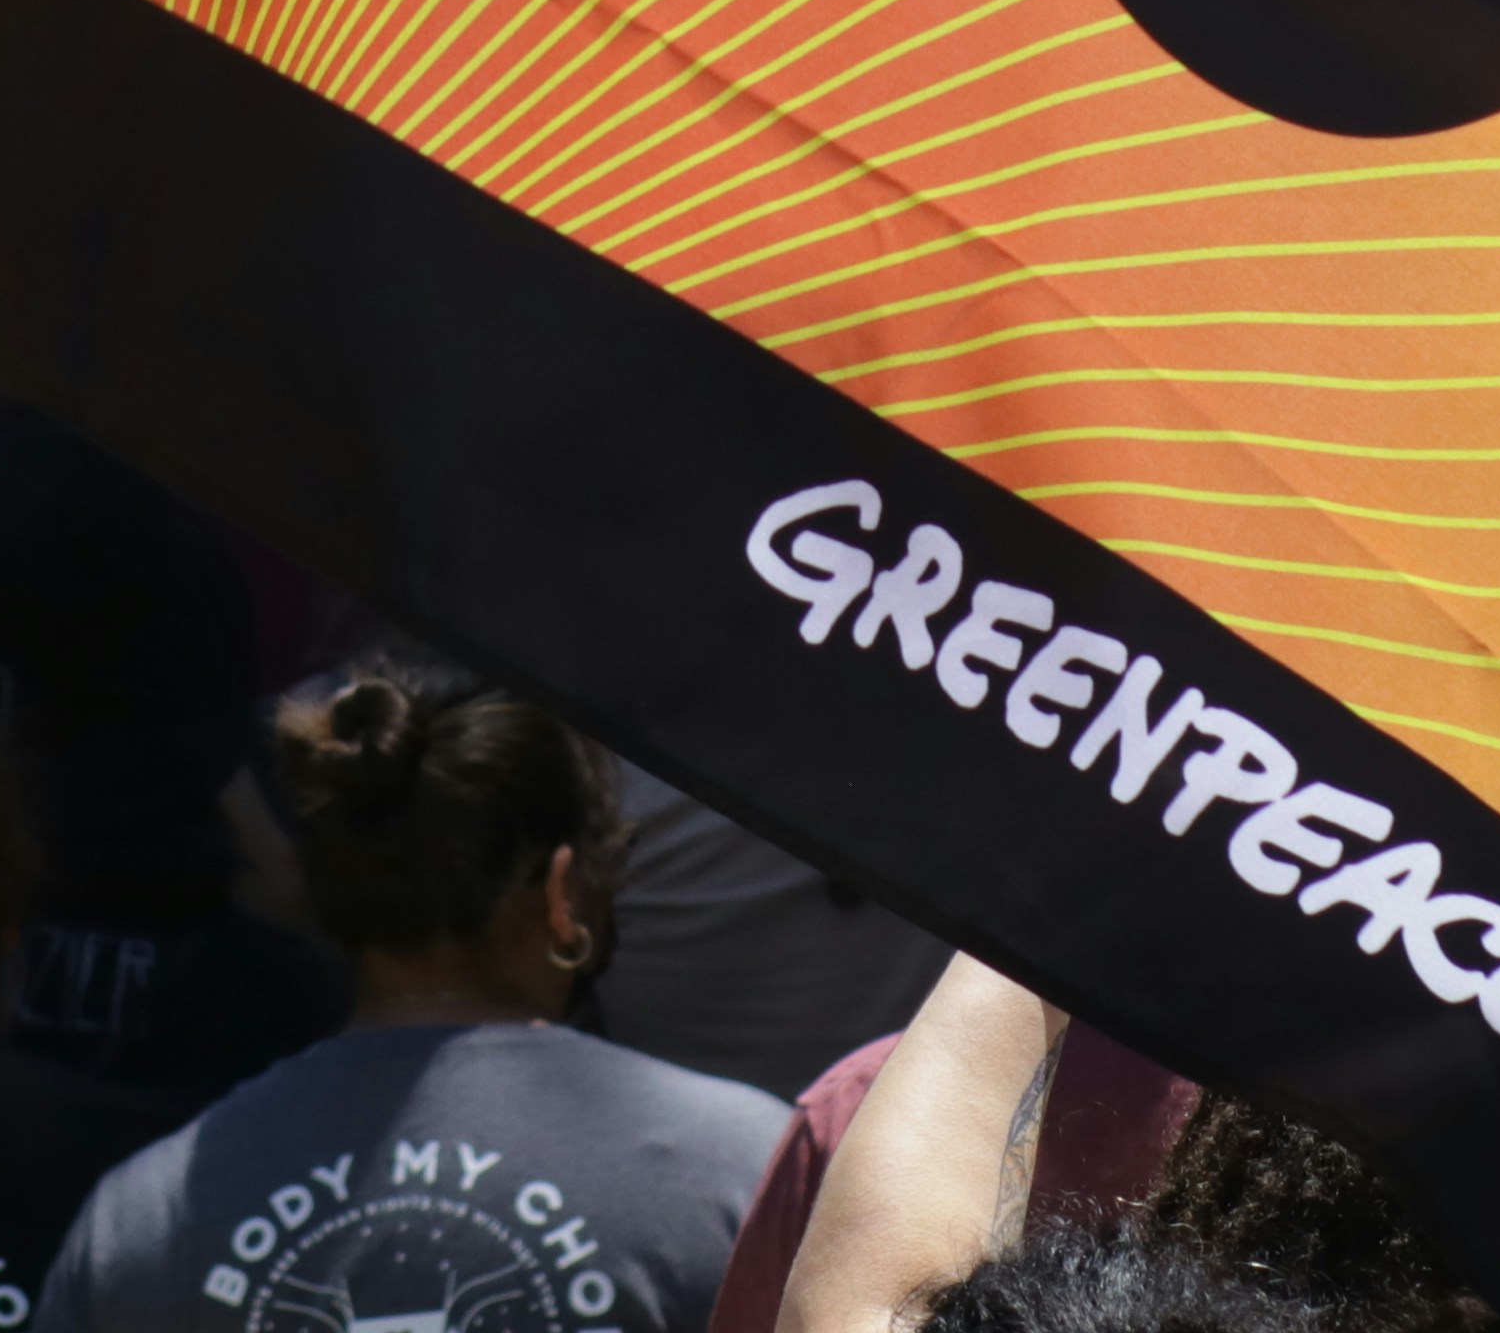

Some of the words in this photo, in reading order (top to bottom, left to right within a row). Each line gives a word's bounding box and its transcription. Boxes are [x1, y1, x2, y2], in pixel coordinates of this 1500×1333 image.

[203, 1153, 355, 1307] BODY
[391, 1140, 502, 1191] MY
[514, 1179, 622, 1333] CHO
